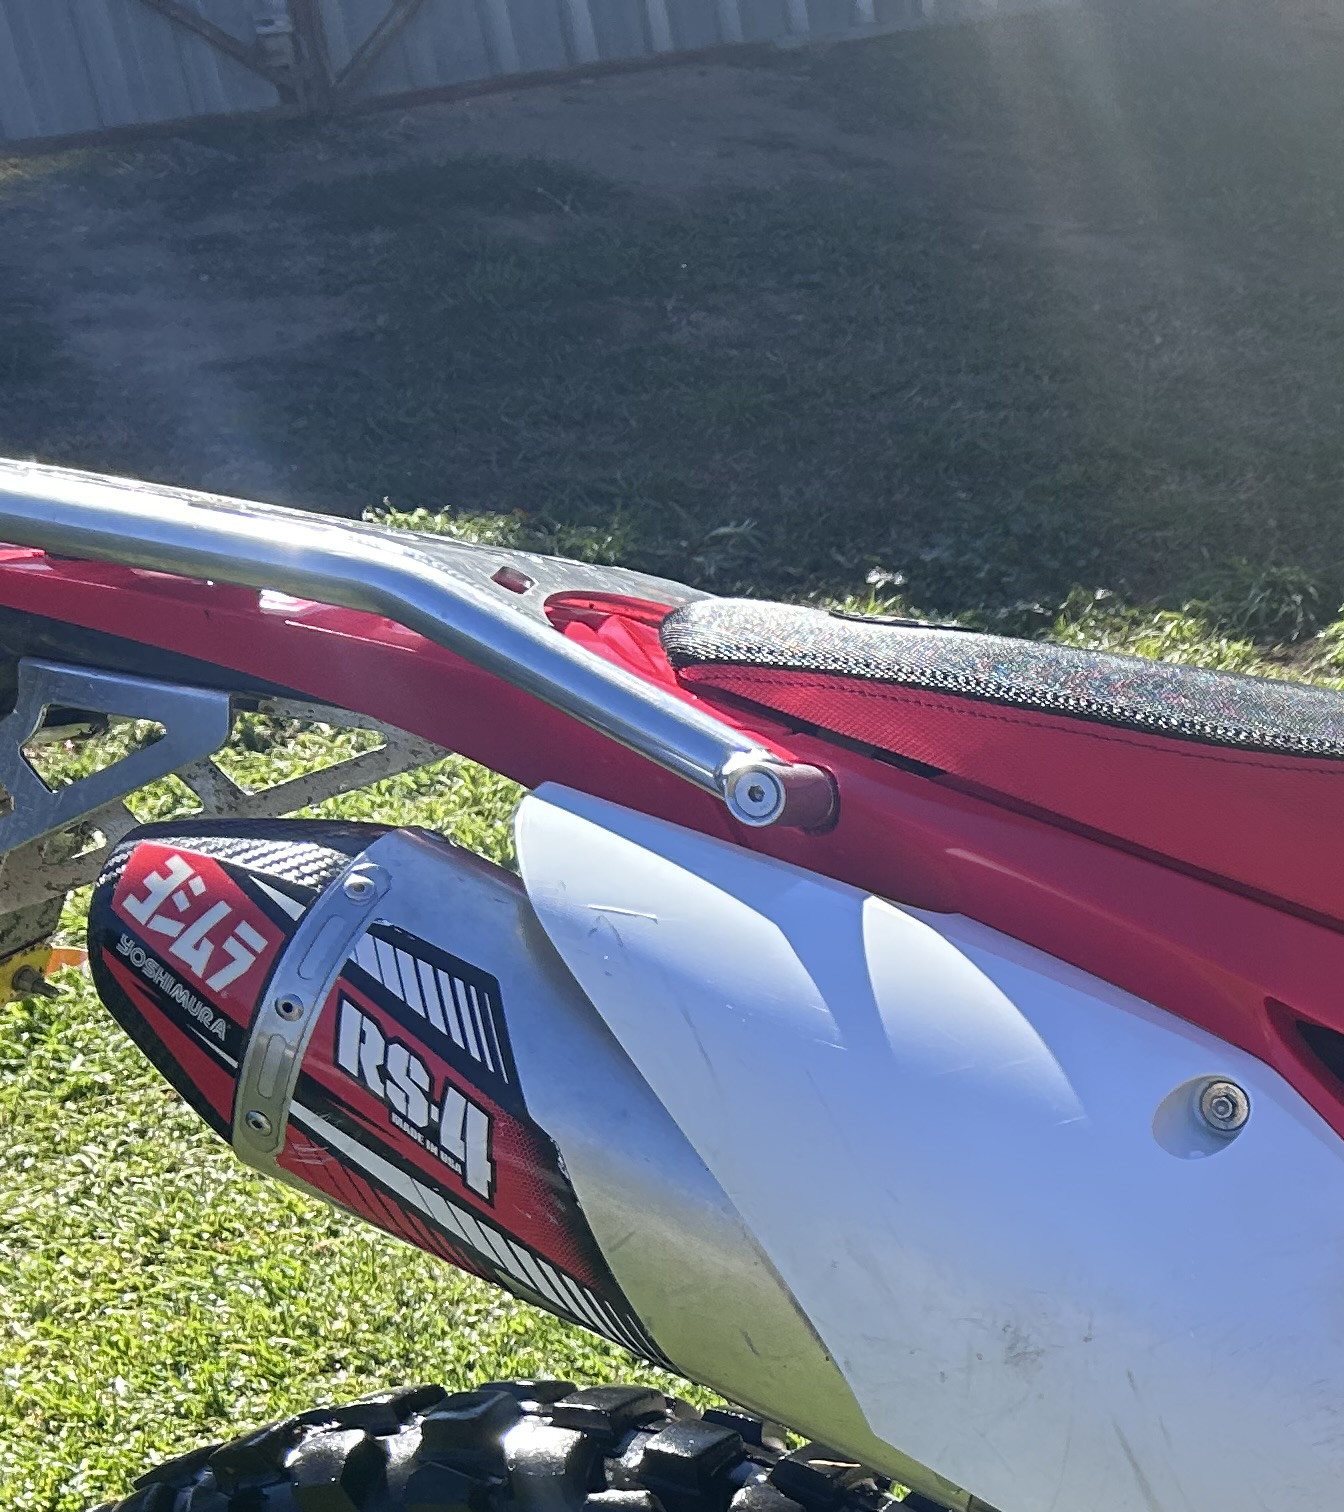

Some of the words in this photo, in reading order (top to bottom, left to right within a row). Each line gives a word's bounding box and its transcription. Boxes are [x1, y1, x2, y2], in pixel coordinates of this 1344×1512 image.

[116, 933, 227, 1042] YOSHIMURA
[391, 1111, 425, 1146] MADE
[425, 1137, 439, 1157] IN
[440, 1149, 463, 1176] USA
